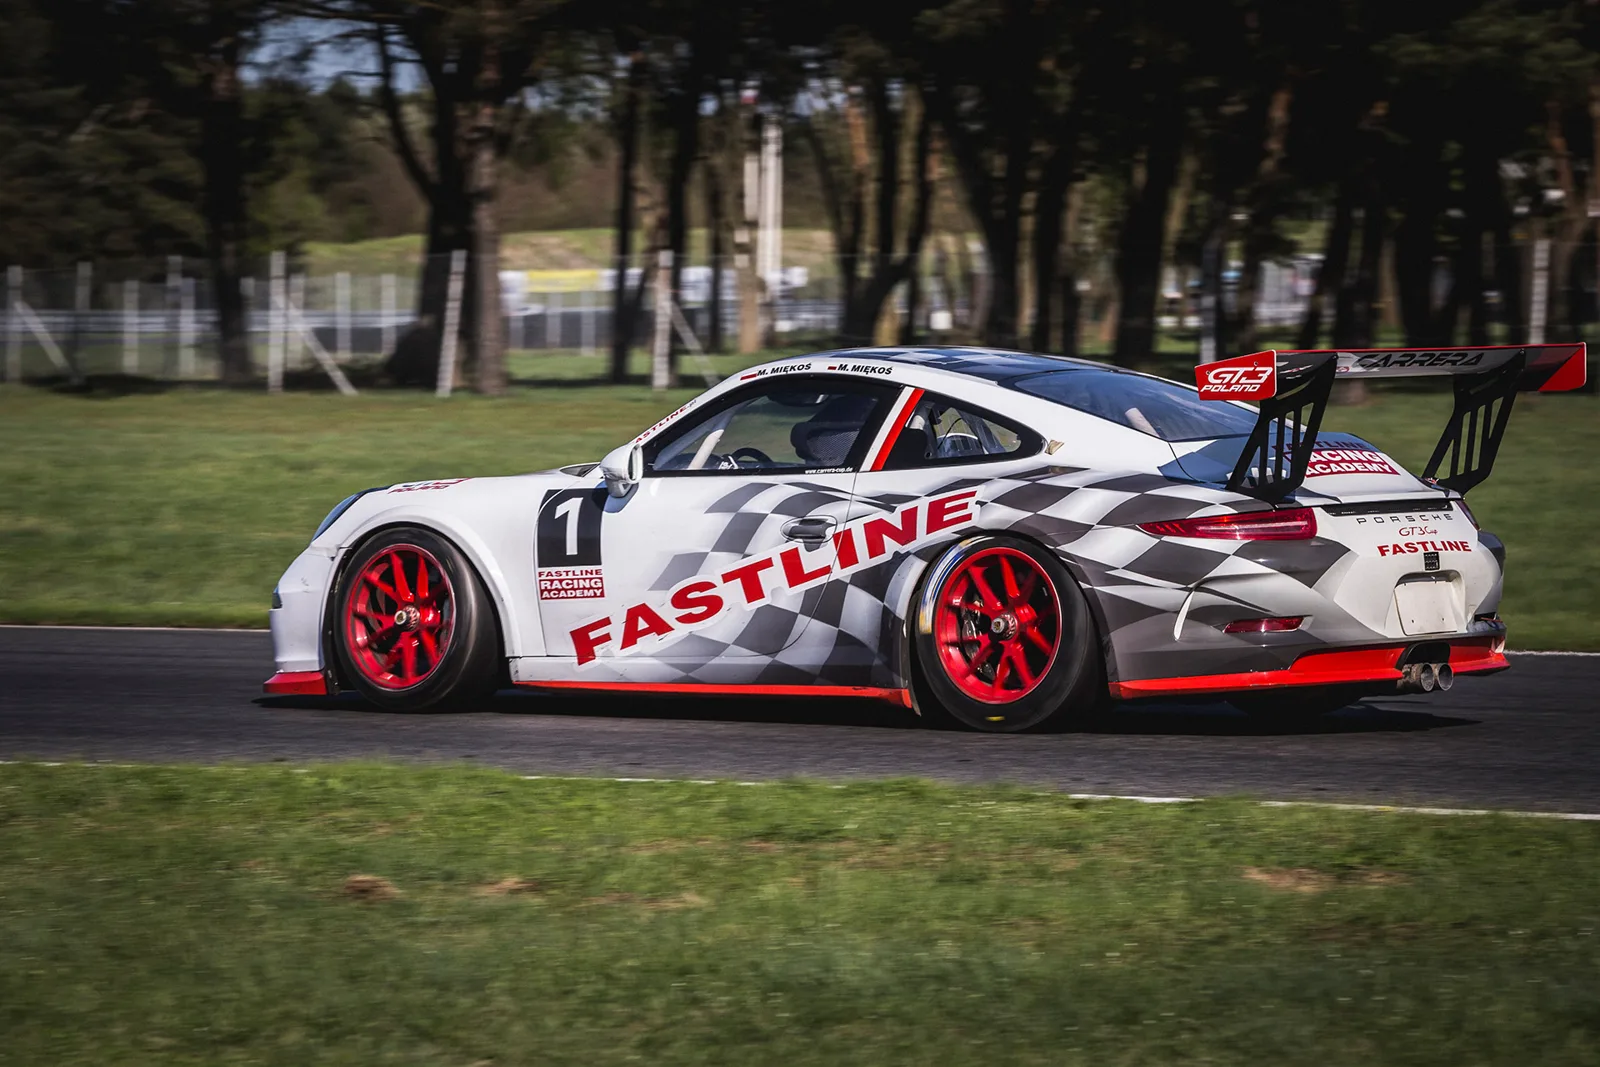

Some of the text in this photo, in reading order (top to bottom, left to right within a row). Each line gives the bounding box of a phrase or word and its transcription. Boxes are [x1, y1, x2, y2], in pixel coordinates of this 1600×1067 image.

[1353, 352, 1485, 369] CARRERA
[757, 362, 812, 377] M. MIĘKOŚ
[837, 363, 893, 376] M. MIĘKOŚ
[1207, 367, 1273, 384] GT3
[1200, 384, 1261, 393] POLAND
[1308, 449, 1383, 463] ACING
[1356, 512, 1454, 525] PORSCHE
[554, 497, 584, 556] 1
[1377, 540, 1472, 557] FASTLINE
[538, 568, 603, 578] FASTLINE
[569, 490, 977, 666] FASTLINE
[540, 578, 603, 590] RACING
[541, 588, 604, 599] ACADEMY
